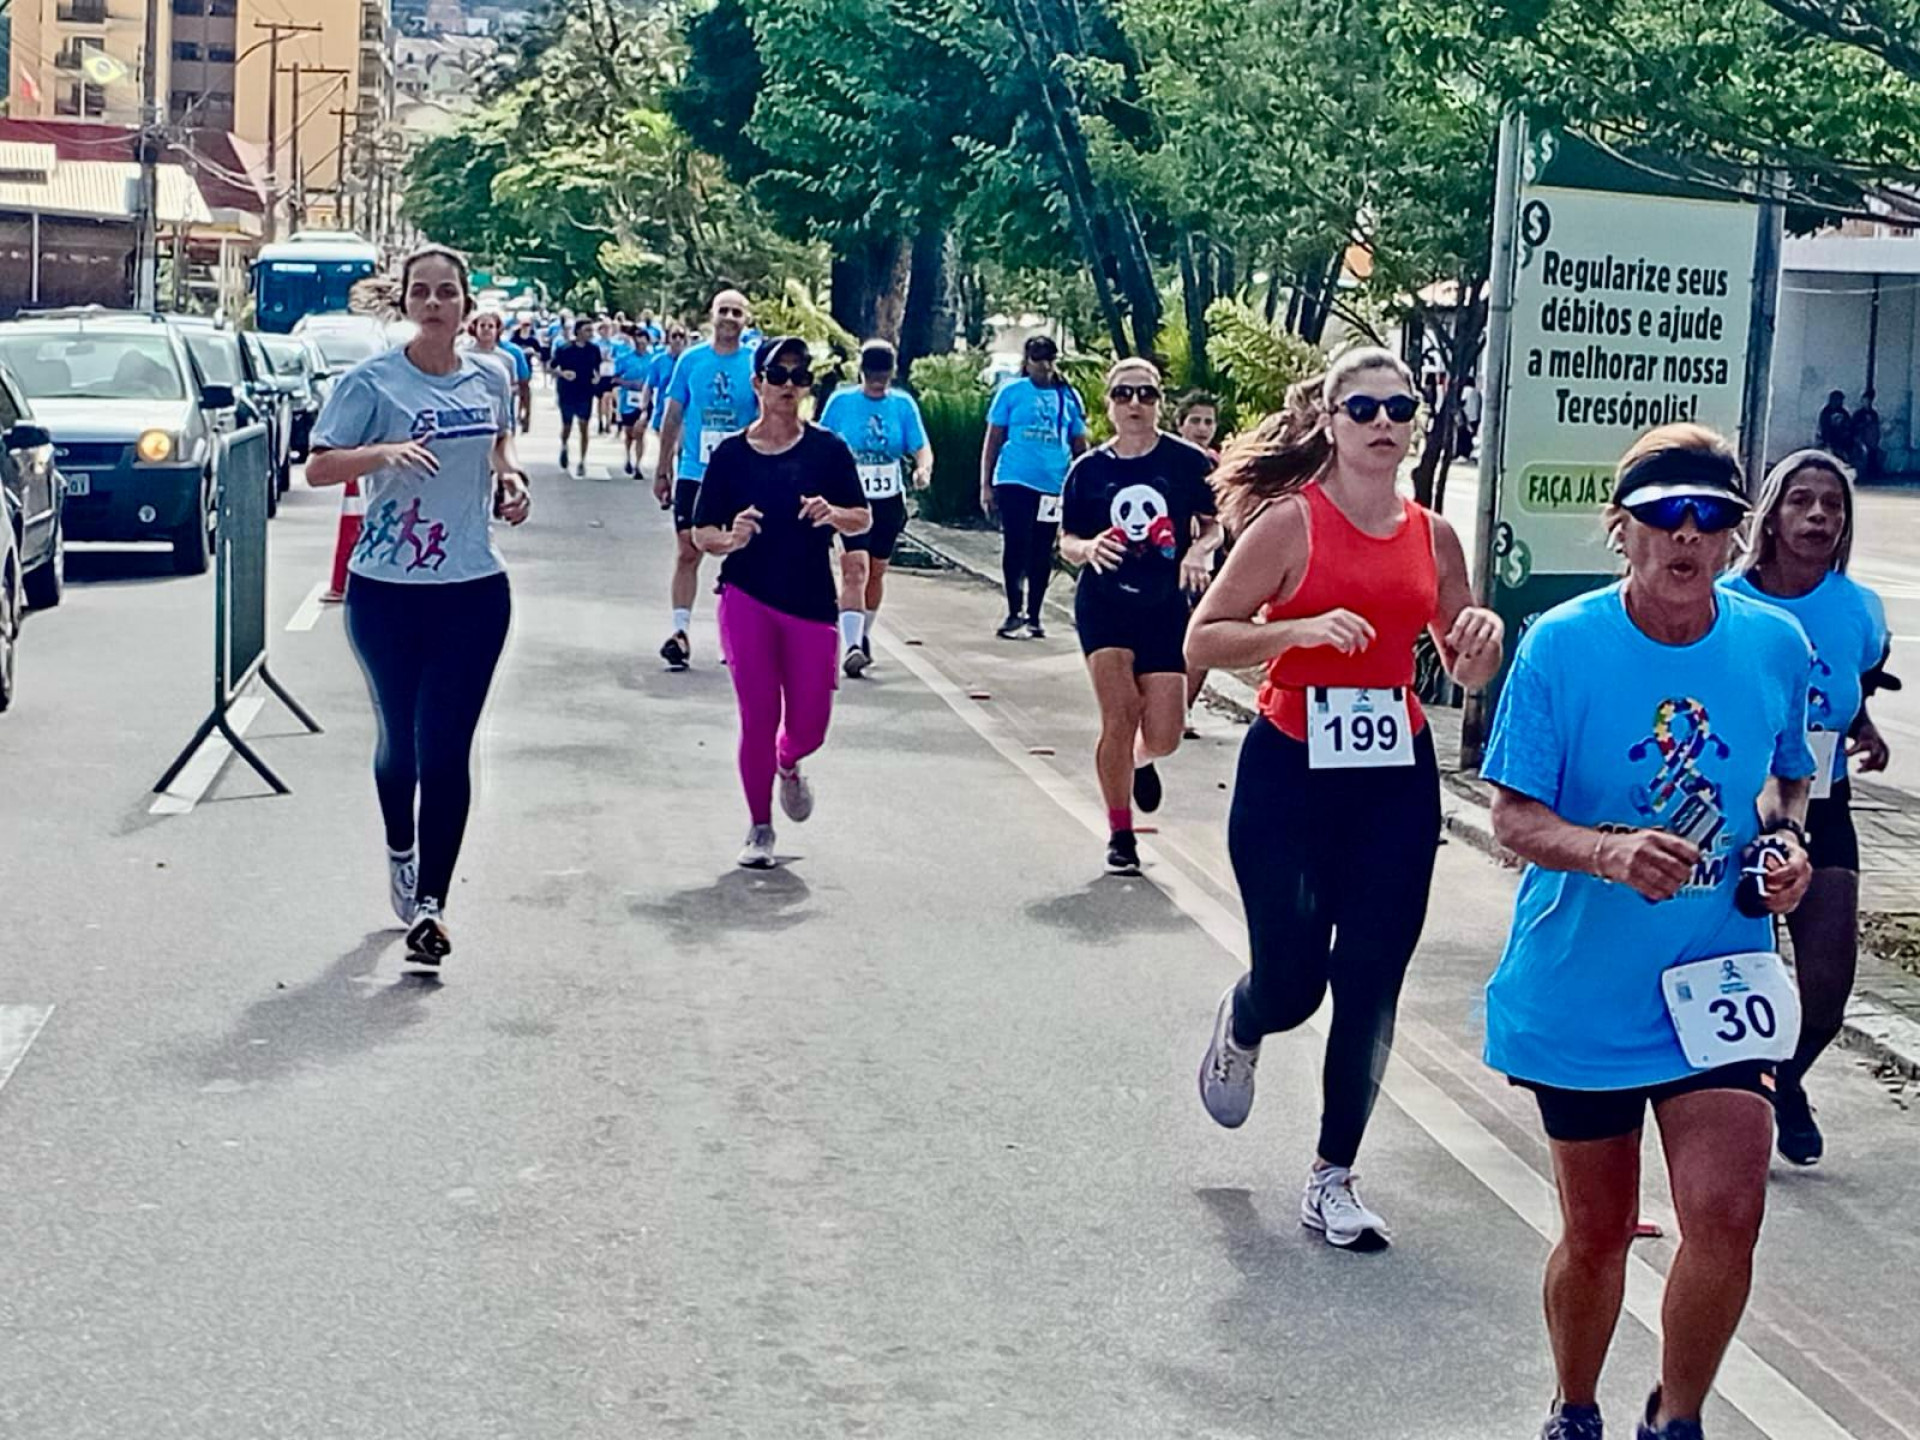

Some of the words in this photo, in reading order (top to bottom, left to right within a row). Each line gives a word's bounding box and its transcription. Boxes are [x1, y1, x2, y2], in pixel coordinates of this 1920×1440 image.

[1542, 250, 1671, 293] Regularize
[1676, 267, 1728, 296] seus
[1541, 296, 1632, 336] débitos
[1638, 309, 1652, 336] e
[1658, 304, 1723, 343] ajude
[1528, 348, 1542, 377] a
[1548, 345, 1658, 381] melhorar
[1663, 355, 1728, 384] nossa
[1556, 388, 1698, 430] Teresópolis!
[864, 477, 892, 492] 133
[1529, 474, 1572, 508] FAÇA
[1576, 470, 1596, 503] JÁ
[1600, 477, 1614, 503] S
[1324, 714, 1398, 752] 199
[1709, 994, 1776, 1043] 30
